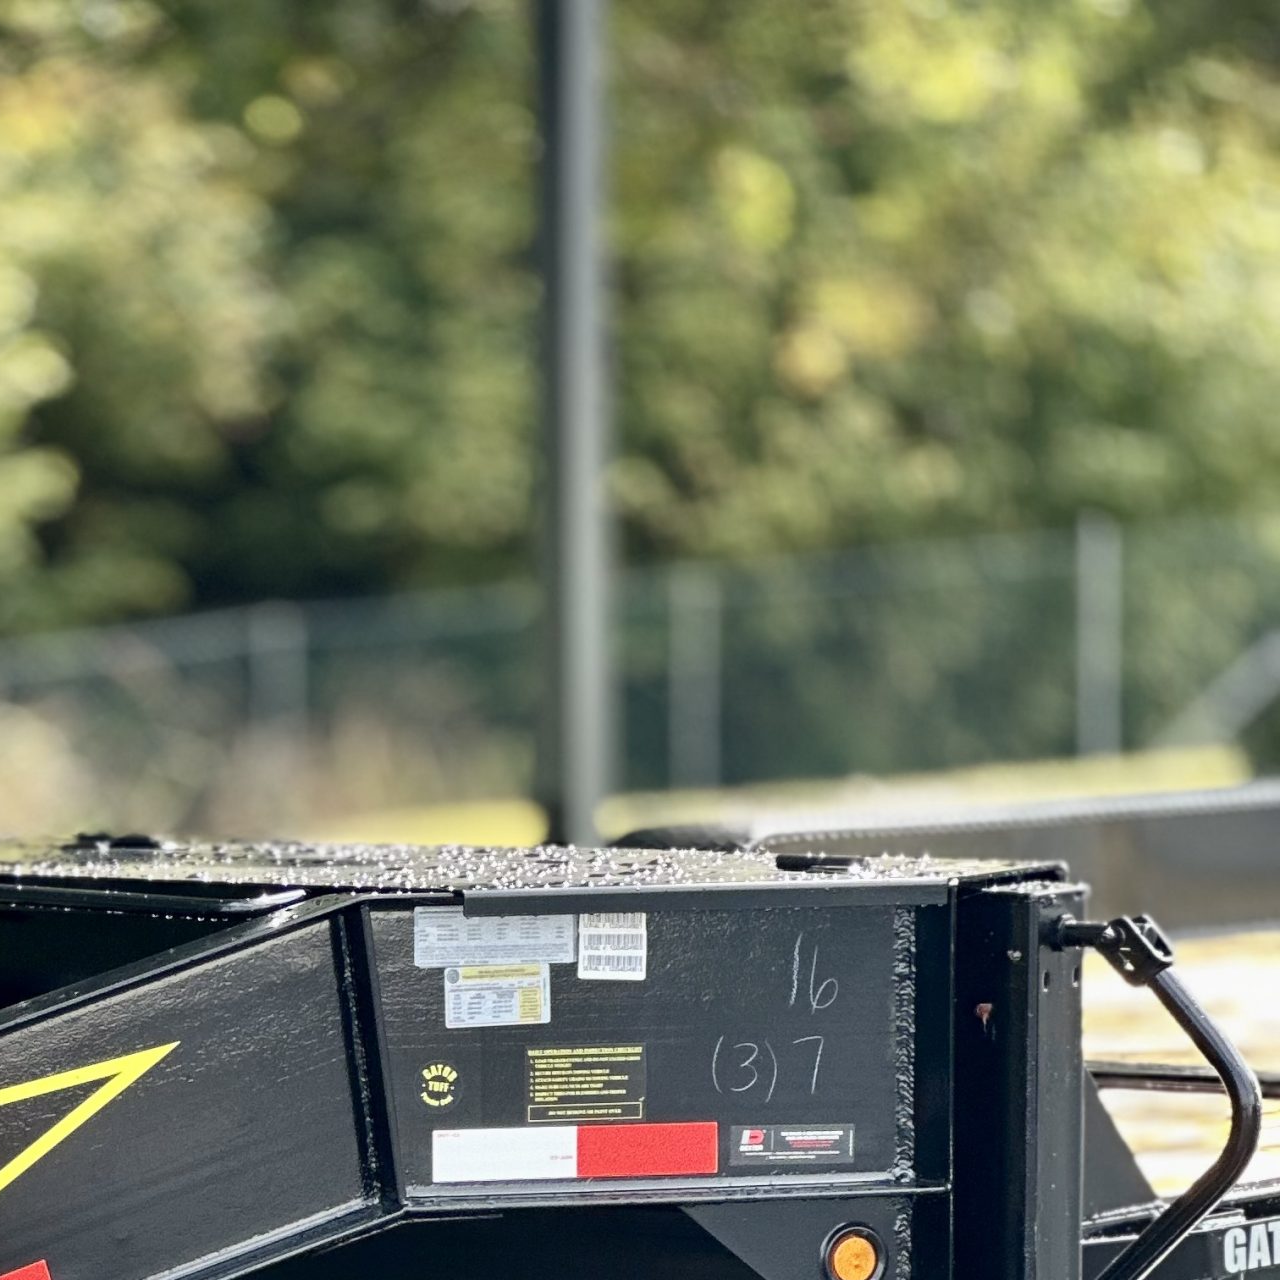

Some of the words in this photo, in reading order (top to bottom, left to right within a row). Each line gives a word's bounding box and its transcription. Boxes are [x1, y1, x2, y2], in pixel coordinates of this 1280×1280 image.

[789, 932, 839, 1015] 16
[422, 1064, 458, 1082] GATOR
[428, 1081, 450, 1092] TUFF
[712, 1035, 777, 1102] (3)
[792, 1035, 824, 1094] 7
